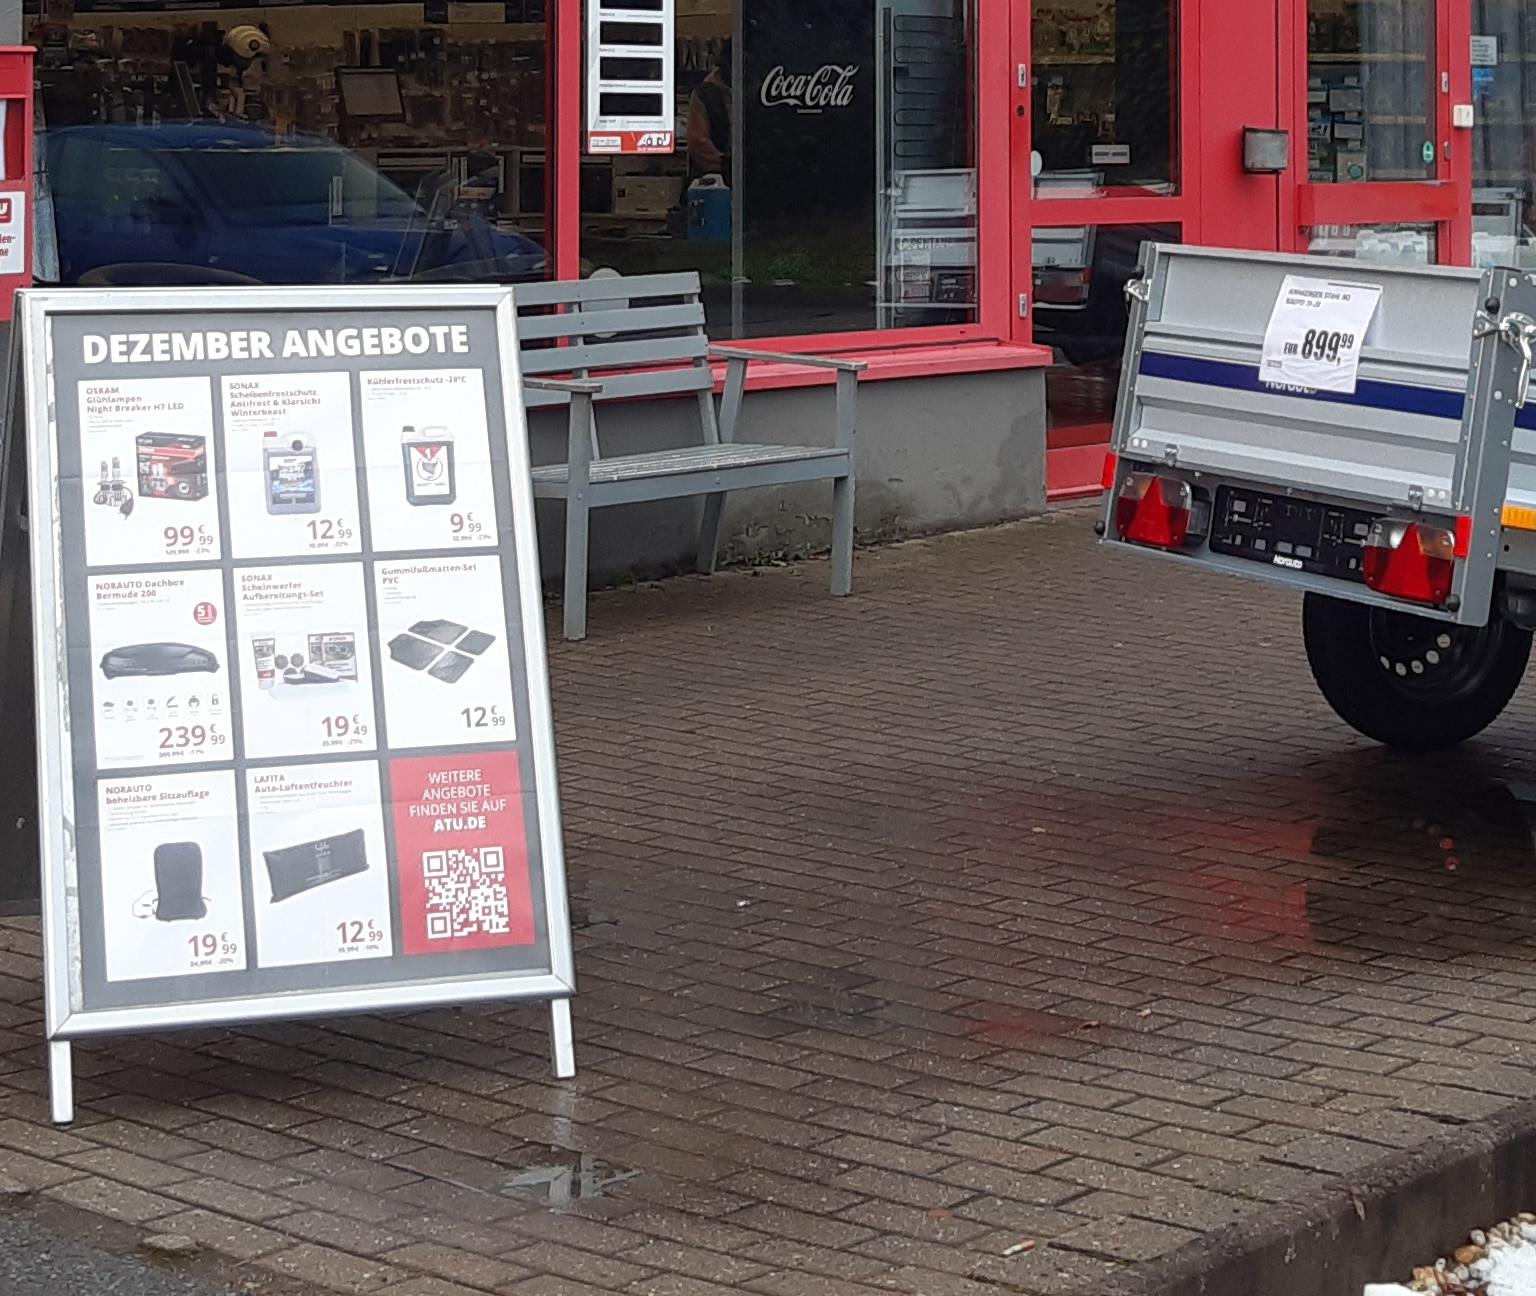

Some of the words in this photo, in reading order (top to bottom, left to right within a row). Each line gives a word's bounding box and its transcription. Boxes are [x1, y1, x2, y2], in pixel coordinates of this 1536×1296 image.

[82, 330, 276, 364] DEZEMBER
[282, 325, 469, 358] ANGEBOTE
[367, 376, 444, 385] Kühlerfrostschutz
[86, 387, 120, 395] OSRAM
[86, 405, 113, 415] Night
[114, 404, 152, 412] Breaker
[167, 402, 184, 411] LED
[306, 519, 335, 540] 12
[449, 512, 464, 534] 9
[163, 525, 196, 547] 99
[95, 580, 143, 590] NORAUTO
[460, 706, 489, 728] 12
[321, 715, 350, 738] 19
[158, 724, 207, 749] 239
[428, 769, 482, 784] WEITERE
[105, 784, 152, 794] NORAUTO
[159, 790, 210, 801] Sitzauflage
[422, 784, 491, 801] ANGEBOTE
[409, 804, 457, 817] FINDEN
[460, 801, 479, 814] SIE
[481, 799, 507, 812] AUF
[433, 815, 487, 833] ATU.DE
[336, 920, 365, 944] 12
[188, 933, 218, 957] 19
